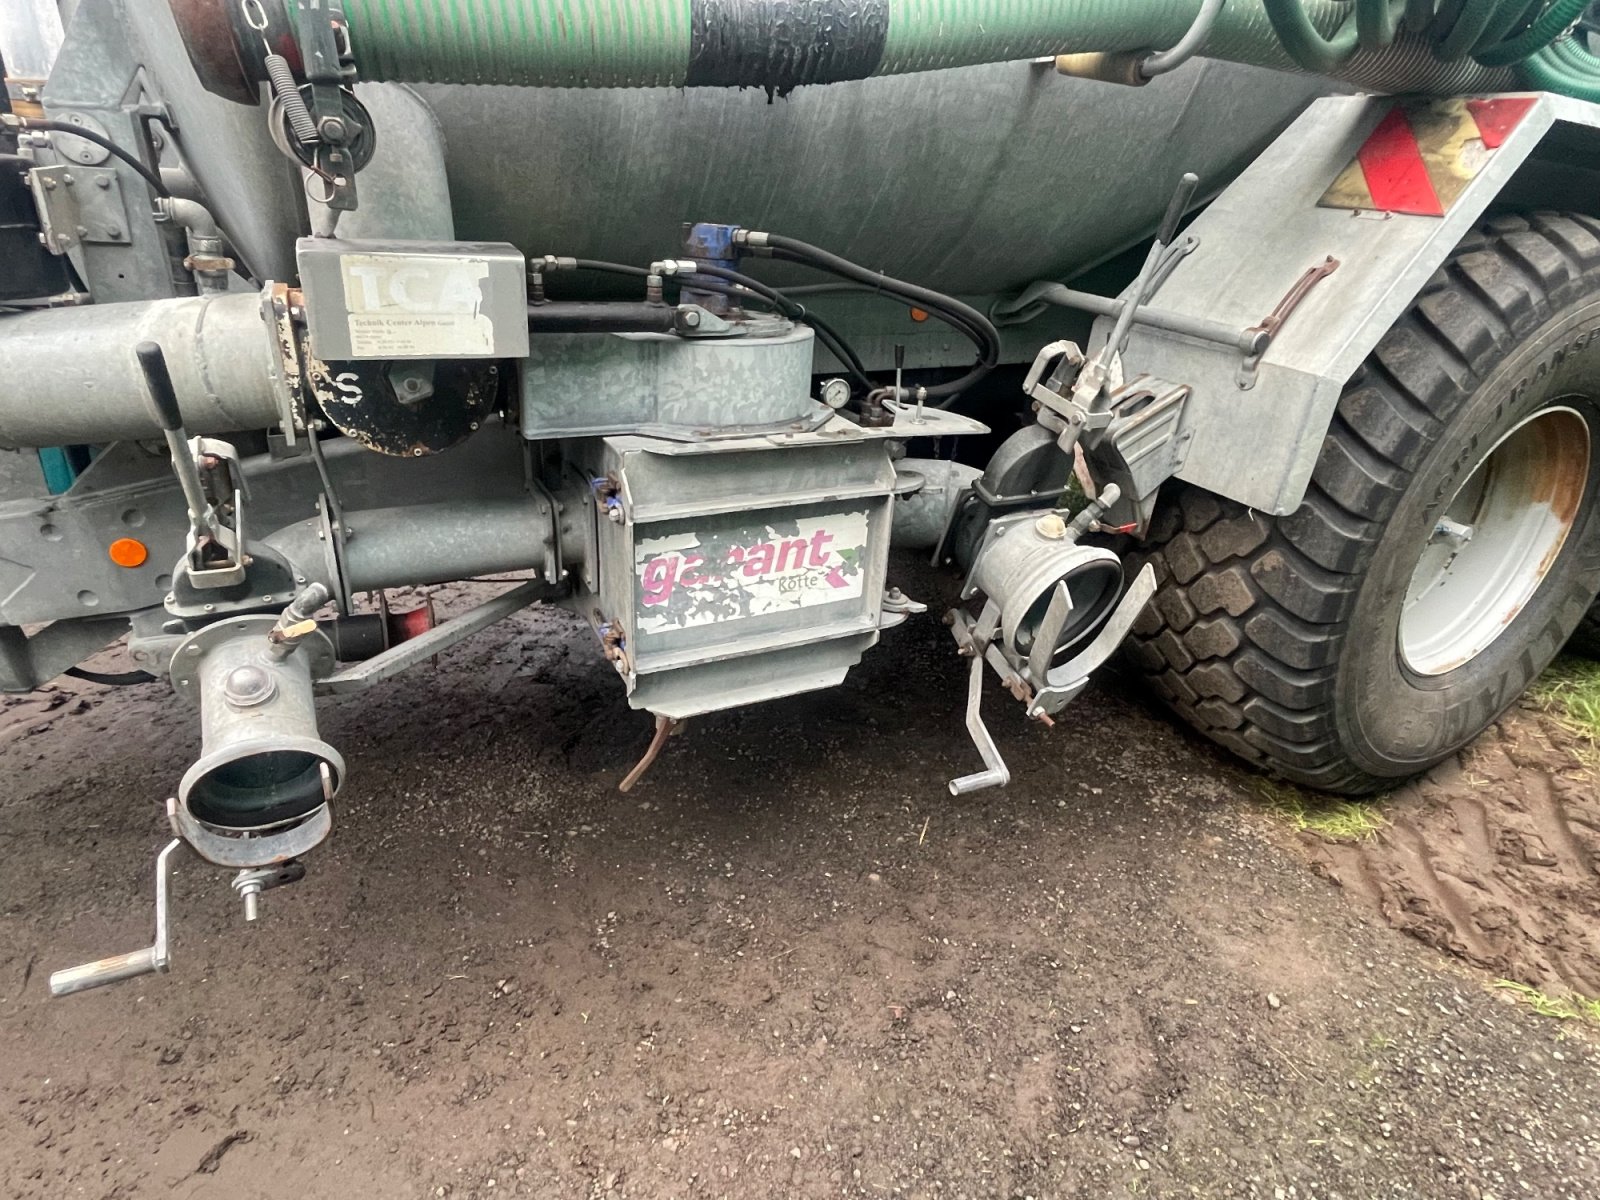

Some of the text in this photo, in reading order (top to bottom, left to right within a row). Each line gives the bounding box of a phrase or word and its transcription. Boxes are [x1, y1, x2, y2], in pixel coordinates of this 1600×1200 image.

[350, 266, 481, 312] TCA
[354, 319, 384, 327] Technik
[387, 319, 412, 327] Center
[414, 319, 436, 328] Alpen
[336, 372, 363, 404] S
